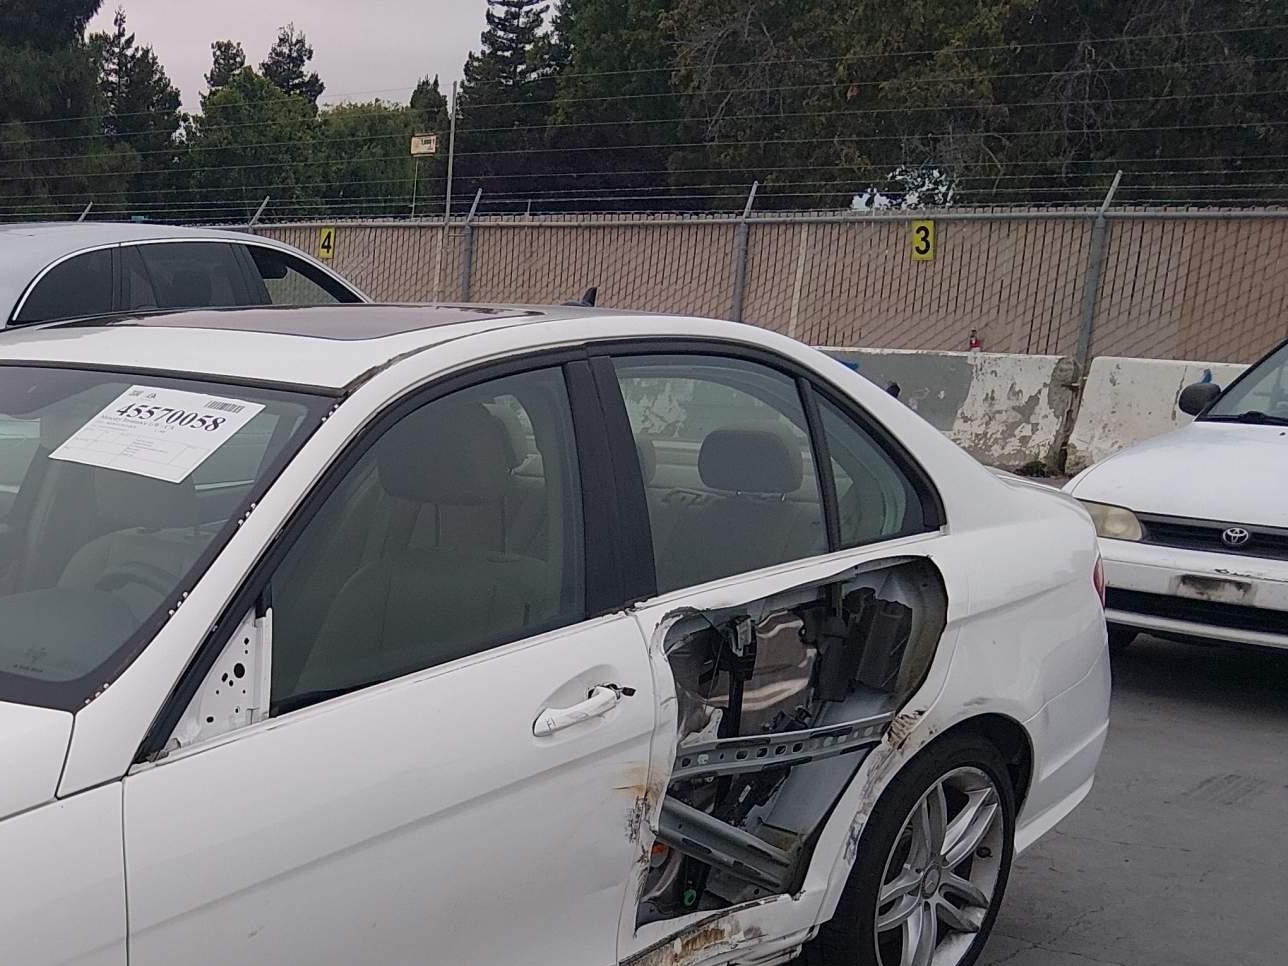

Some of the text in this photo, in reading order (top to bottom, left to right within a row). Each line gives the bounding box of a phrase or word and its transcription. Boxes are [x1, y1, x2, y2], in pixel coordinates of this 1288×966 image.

[321, 231, 332, 254] 4
[914, 225, 931, 255] 3
[116, 402, 227, 432] 45570058
